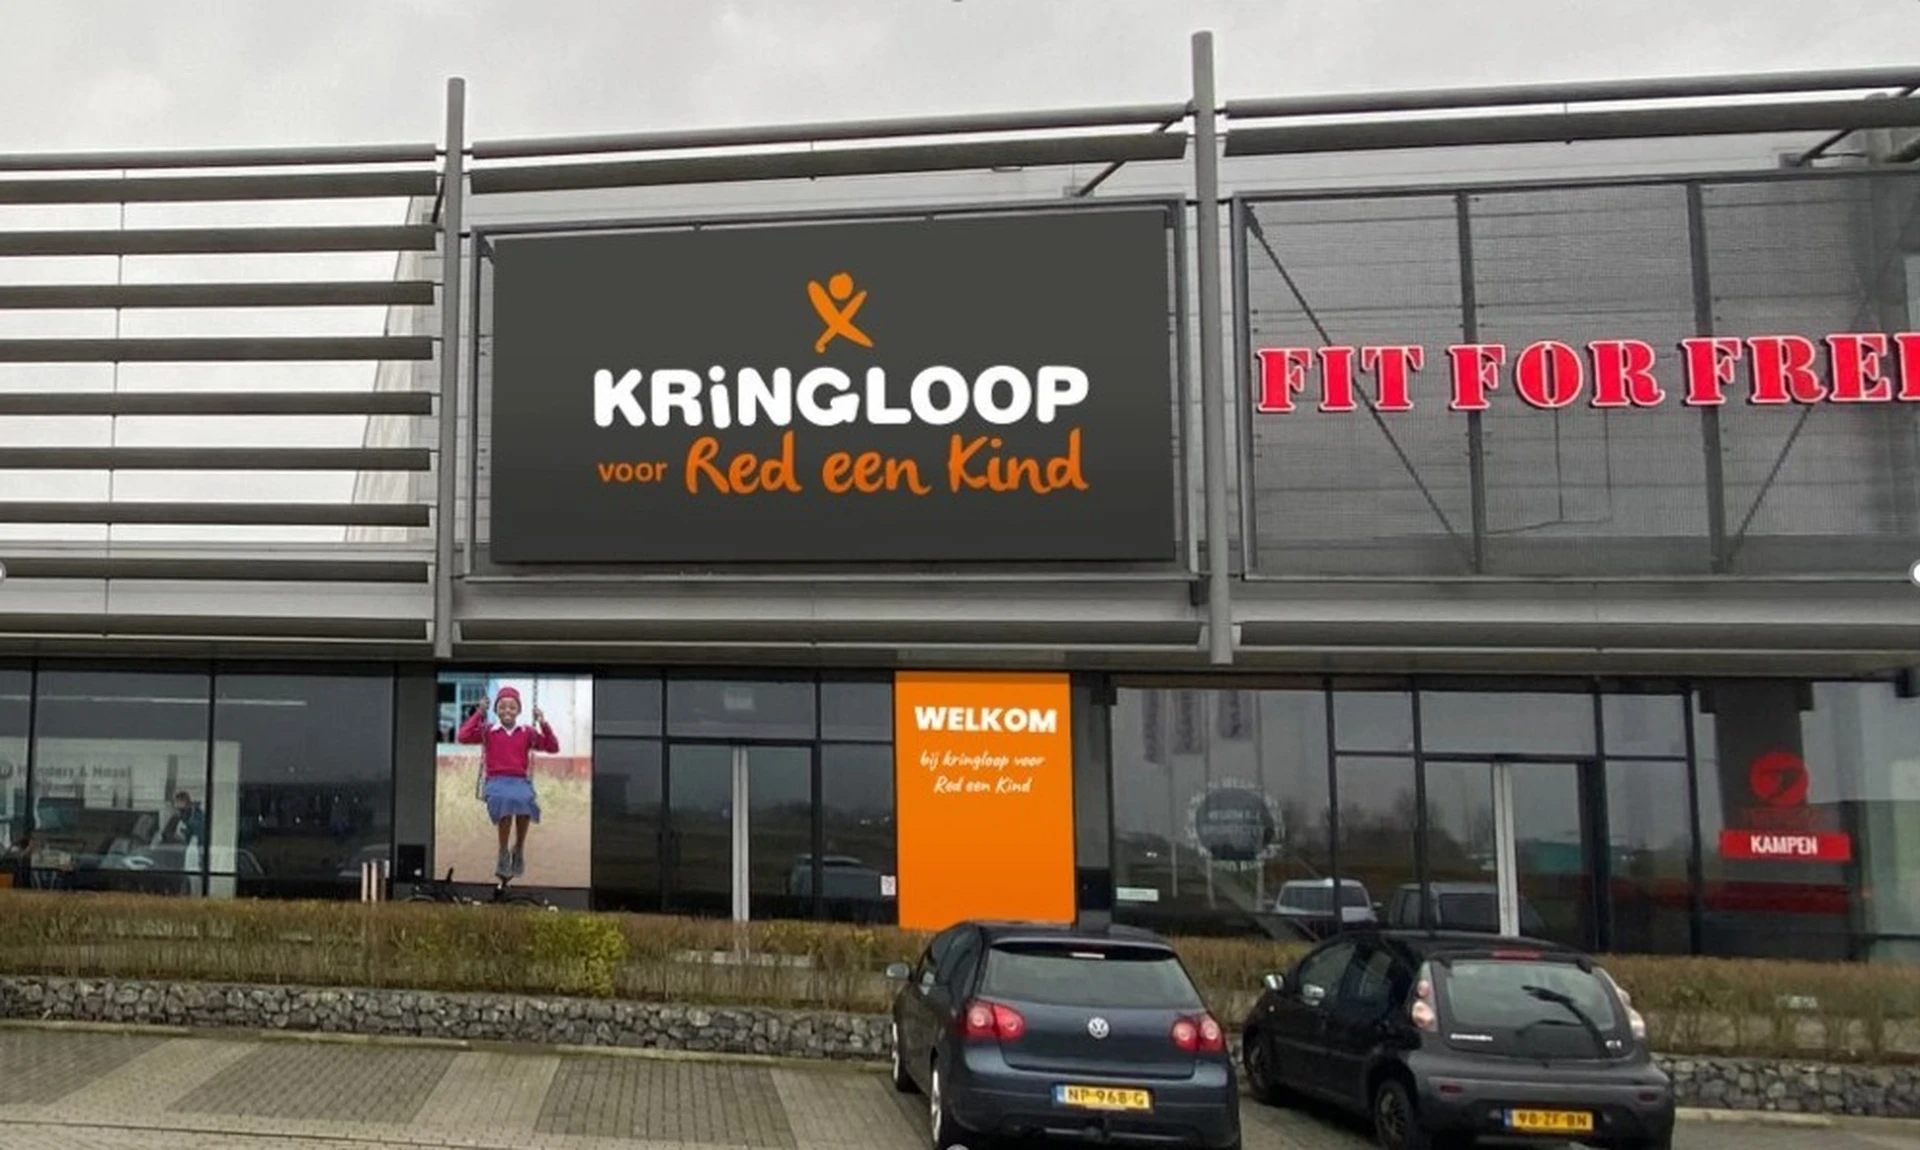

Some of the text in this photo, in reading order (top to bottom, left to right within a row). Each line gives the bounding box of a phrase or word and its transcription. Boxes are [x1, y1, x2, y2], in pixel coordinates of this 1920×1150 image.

[1257, 345, 1424, 413] FIT
[1449, 340, 1663, 411] FOR
[597, 427, 1090, 496] voor Red een Kind
[914, 706, 1057, 733] WELKOM
[920, 749, 1046, 771] bij kringloop voor
[934, 775, 1033, 793] Red een Kind
[1750, 834, 1818, 855] KAMPEN
